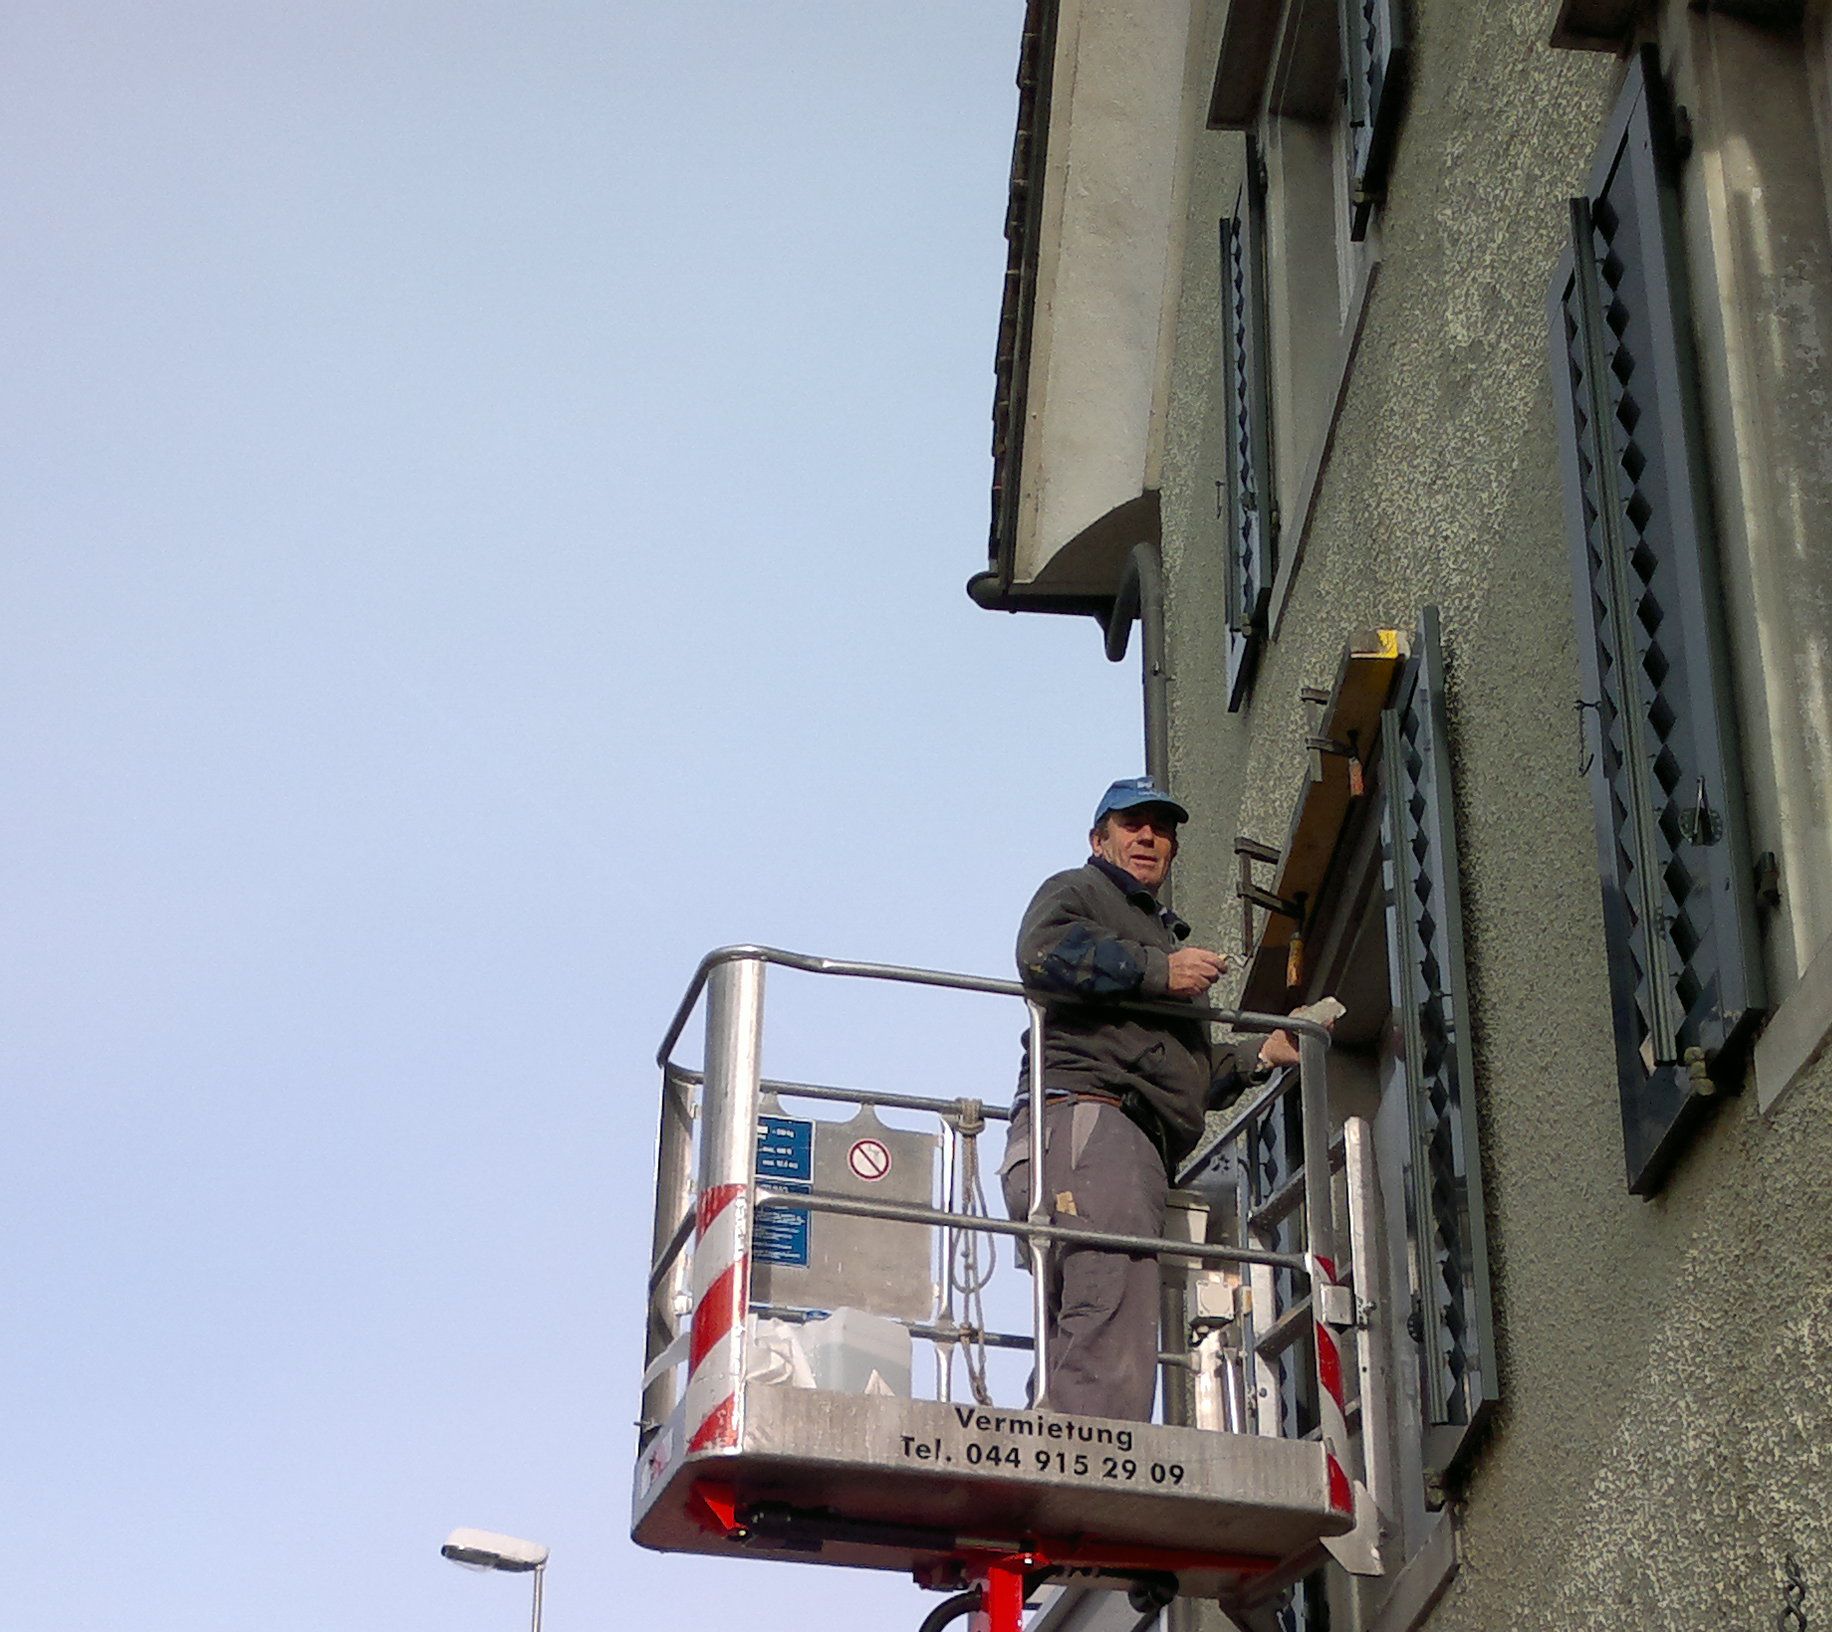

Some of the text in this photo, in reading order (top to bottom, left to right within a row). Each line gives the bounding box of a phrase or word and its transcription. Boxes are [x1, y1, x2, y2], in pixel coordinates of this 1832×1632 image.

[954, 1406, 1133, 1452] Vermietung
[900, 1435, 1185, 1486] Tel. 044 915 29 09
